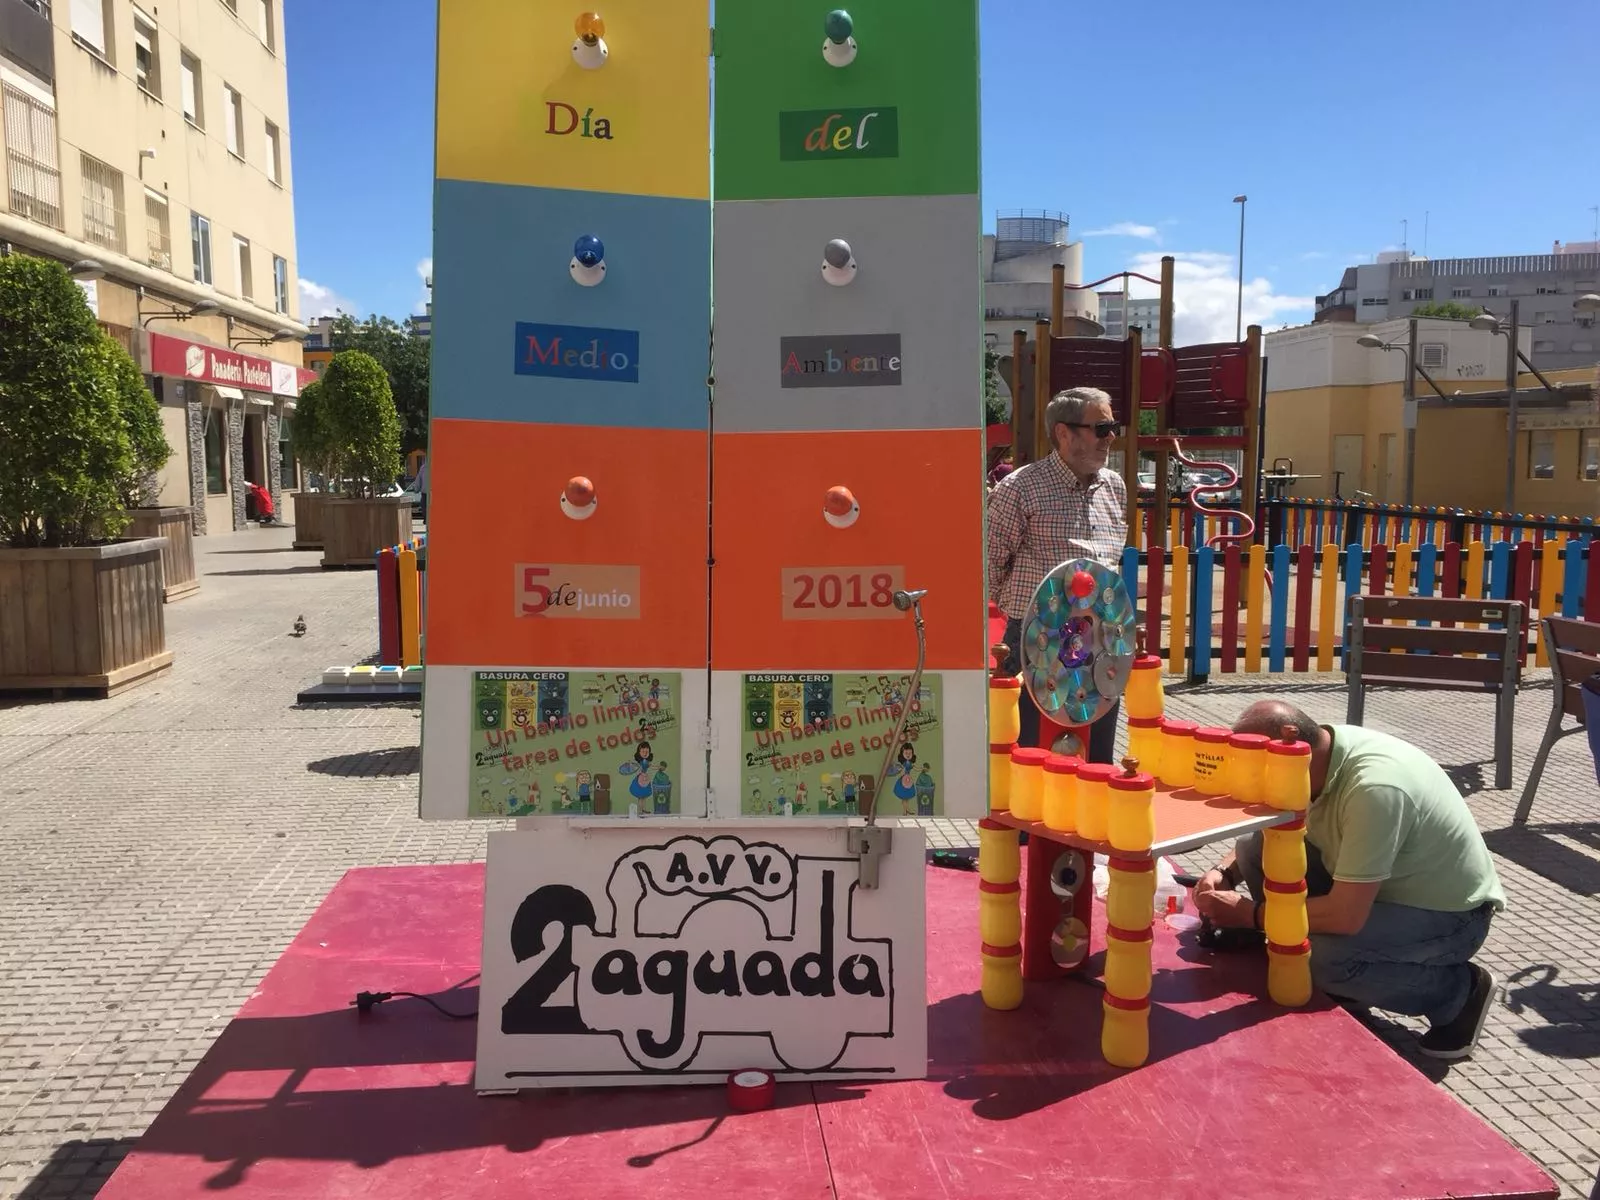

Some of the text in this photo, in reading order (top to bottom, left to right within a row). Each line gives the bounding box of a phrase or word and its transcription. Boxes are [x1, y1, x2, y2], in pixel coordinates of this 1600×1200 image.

[545, 101, 614, 140] Día
[804, 111, 879, 153] del
[524, 334, 629, 371] Medio
[782, 348, 901, 375] Ambiente
[793, 572, 894, 609] 2018
[479, 672, 566, 681] BASURA CERO
[749, 674, 830, 683] BASURA CERO
[485, 697, 661, 748] Un barrio limpio
[755, 699, 921, 749] Un barrio limpo
[500, 723, 658, 773] tarea de todos
[770, 747, 825, 773] tarea
[830, 740, 856, 760] de
